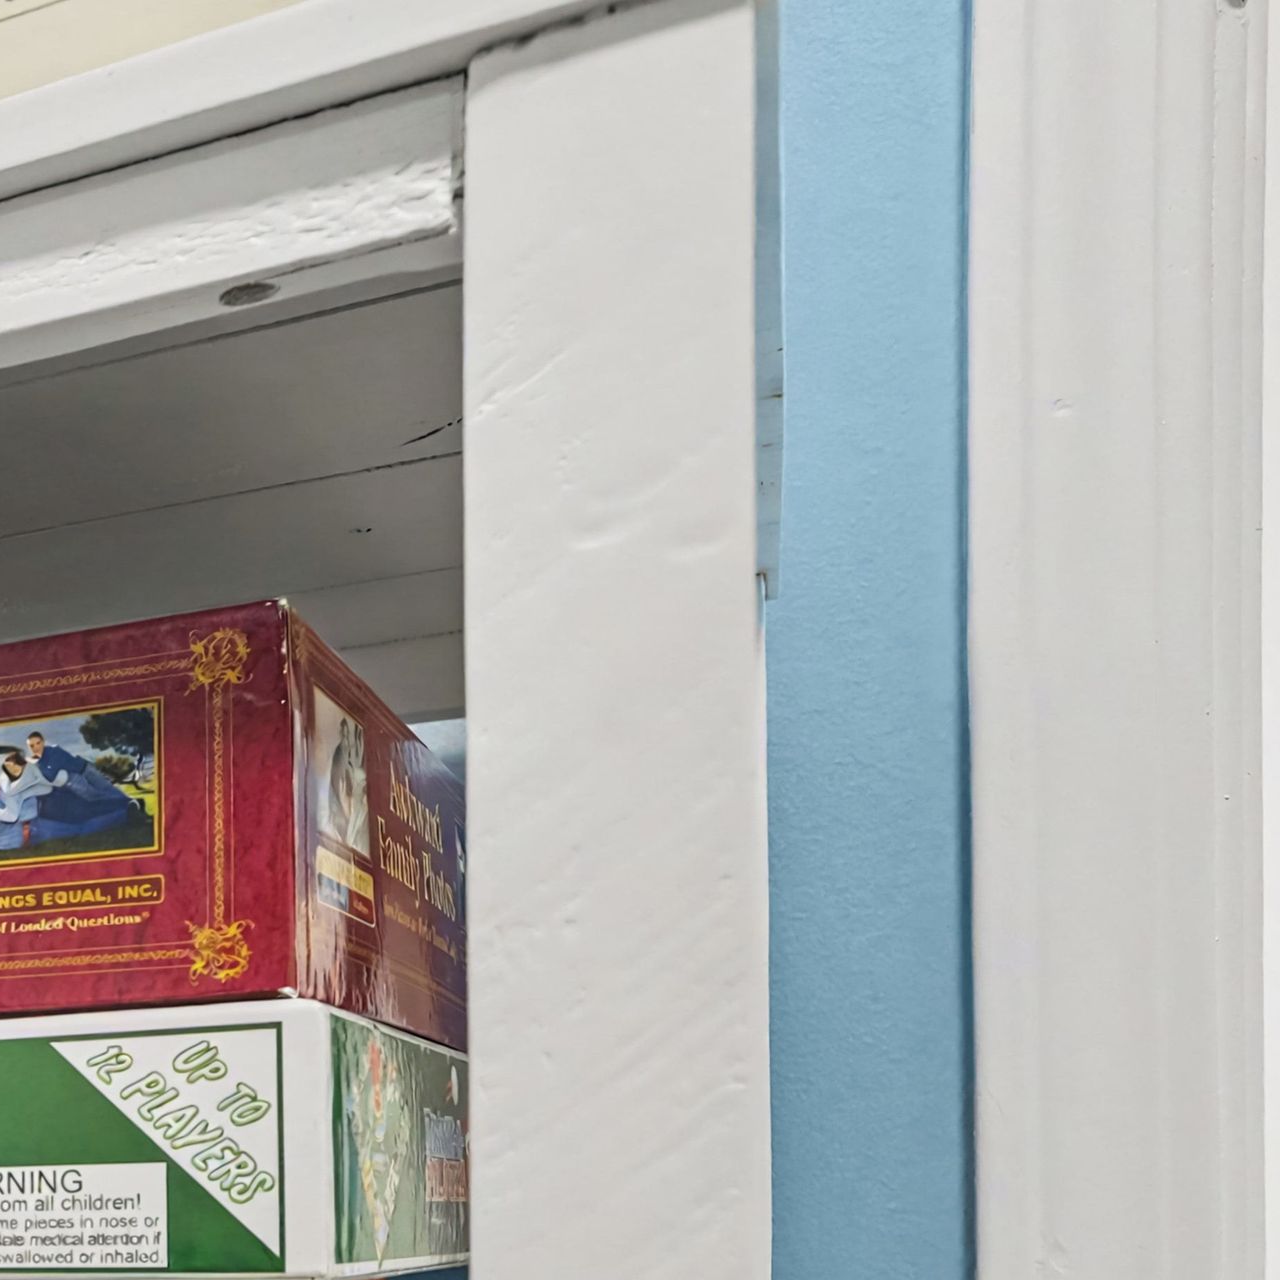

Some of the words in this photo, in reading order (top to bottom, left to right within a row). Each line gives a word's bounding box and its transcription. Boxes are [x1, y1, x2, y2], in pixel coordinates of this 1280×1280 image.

[377, 815, 421, 910] Family
[42, 887, 112, 906] EQUAL,
[117, 883, 158, 900] INC.
[171, 1039, 228, 1084] UP
[216, 1081, 271, 1128] TO
[86, 1044, 134, 1085] 12
[120, 1071, 276, 1205] PLAYERS
[34, 1194, 55, 1212] all
[61, 1193, 142, 1212] children!
[24, 1216, 74, 1233] pieces
[79, 1214, 95, 1229] in
[98, 1216, 138, 1229] nose
[143, 1216, 160, 1229] or
[29, 1232, 84, 1247] medical
[88, 1232, 149, 1247] attention
[151, 1231, 162, 1246] if
[79, 1250, 93, 1265] or
[99, 1249, 164, 1265] inhaled.
